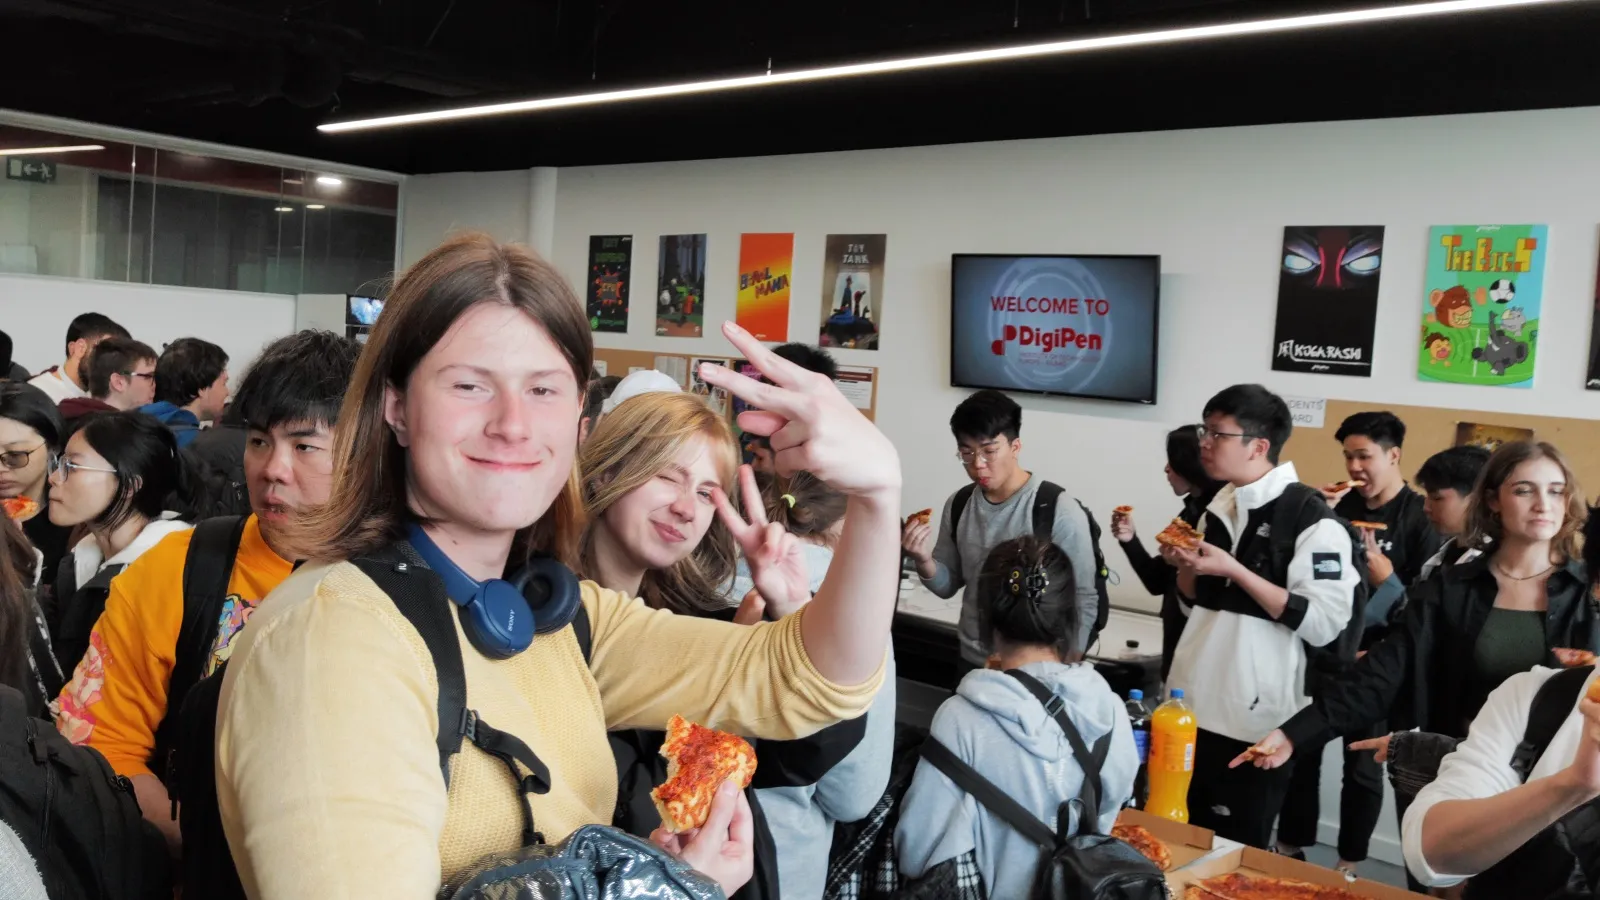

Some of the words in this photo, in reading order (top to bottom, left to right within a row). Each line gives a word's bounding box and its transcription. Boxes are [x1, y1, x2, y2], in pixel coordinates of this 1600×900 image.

[842, 254, 869, 264] TANK
[1441, 235, 1474, 271] THE
[991, 296, 1079, 314] WELCOME
[1084, 299, 1110, 316] TO
[1019, 326, 1102, 353] DigiPen
